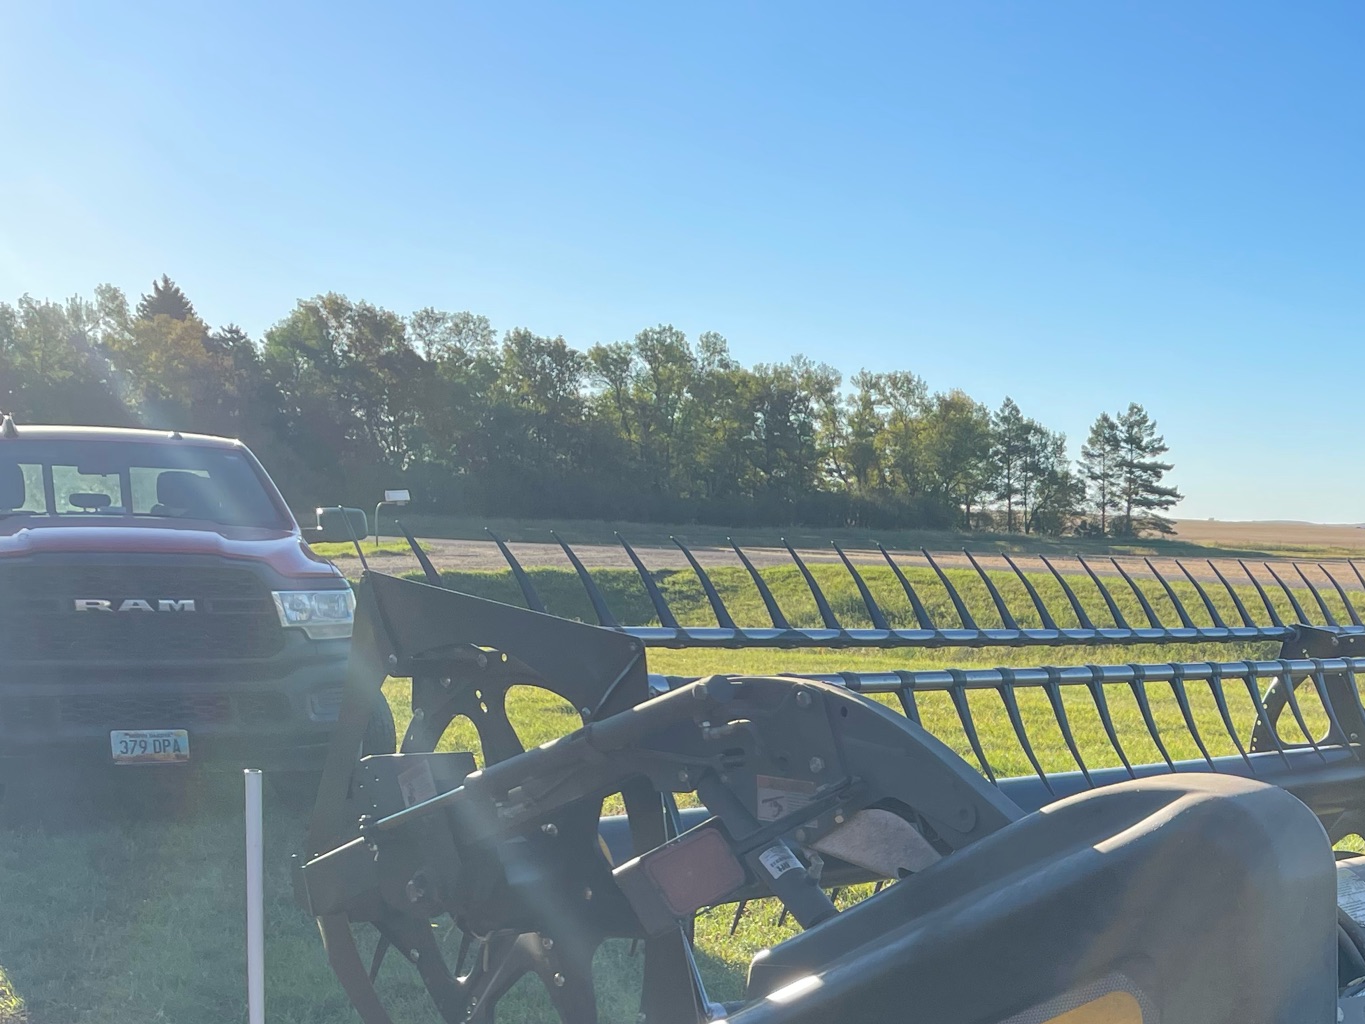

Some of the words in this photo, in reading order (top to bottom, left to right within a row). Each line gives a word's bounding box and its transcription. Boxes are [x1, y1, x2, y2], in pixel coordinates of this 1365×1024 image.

[75, 599, 195, 612] RAM
[120, 740, 147, 754] 379
[153, 739, 181, 754] DPA
